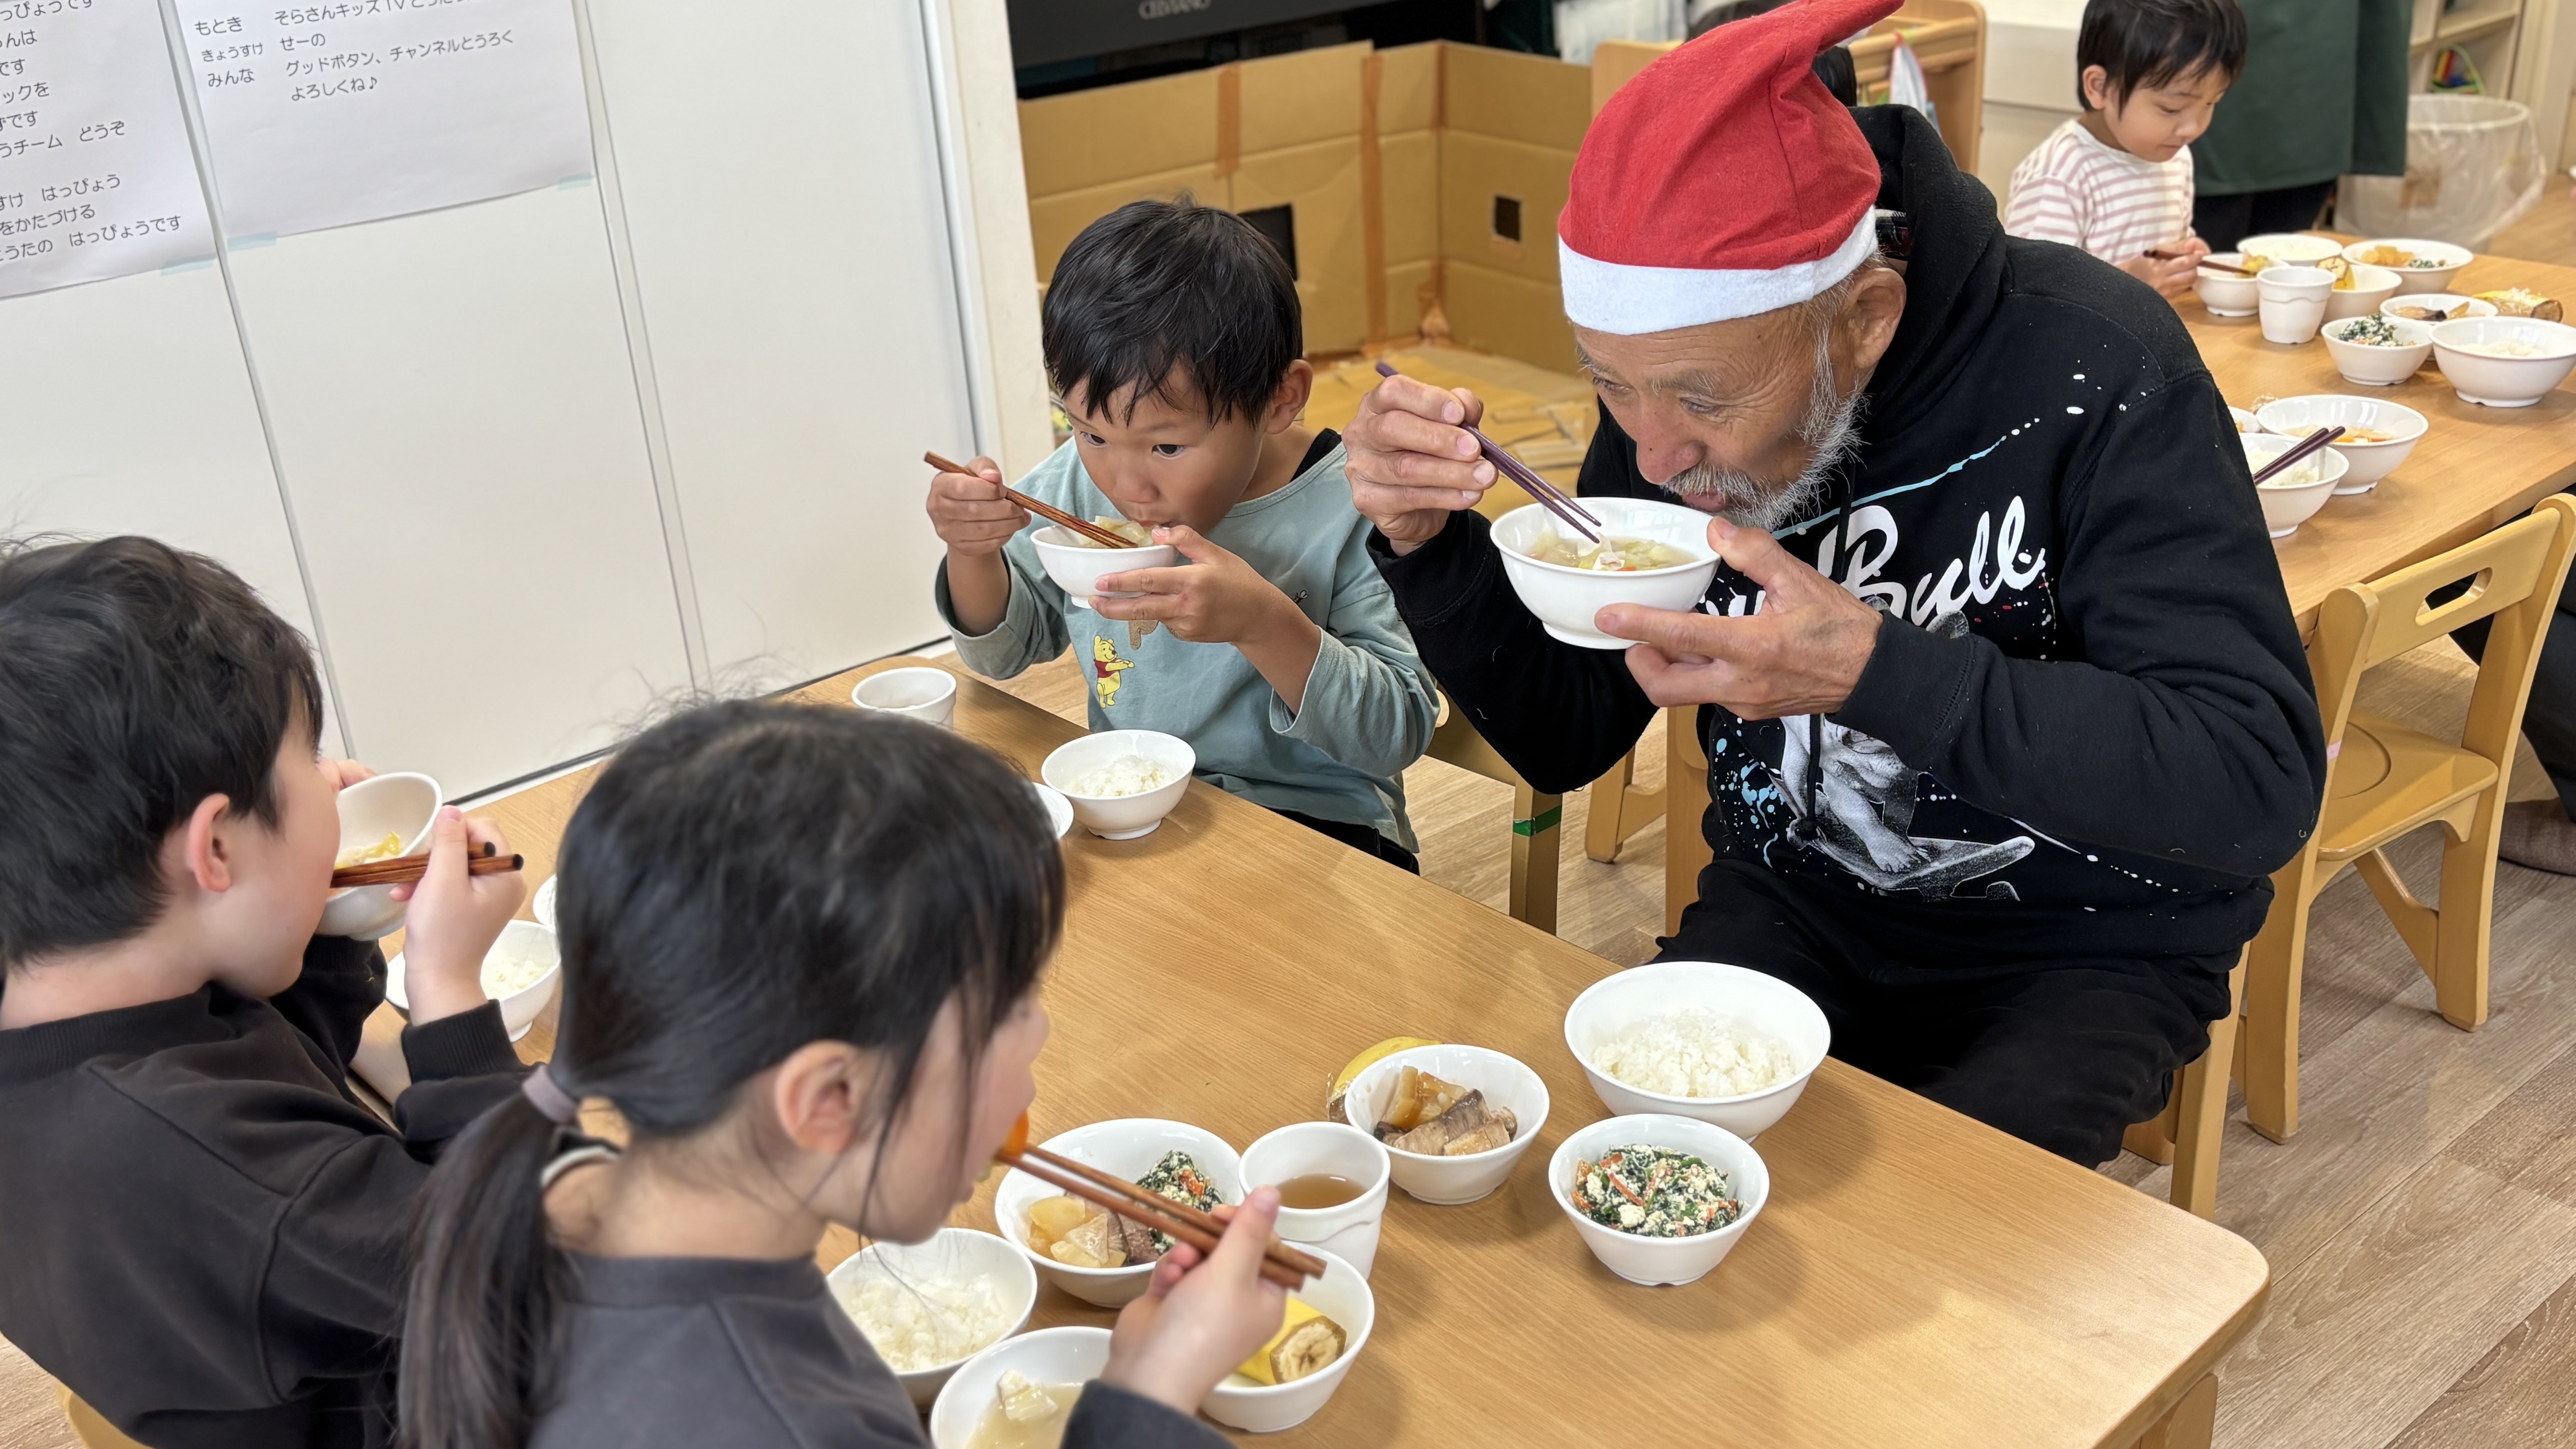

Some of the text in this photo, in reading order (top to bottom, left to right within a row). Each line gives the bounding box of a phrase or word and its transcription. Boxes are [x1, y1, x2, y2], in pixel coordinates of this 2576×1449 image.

[0, 29, 37, 48] んは
[194, 17, 242, 36] もとき
[201, 33, 326, 62] きょうすけ せーの
[207, 69, 255, 87] みんな
[3, 82, 50, 104] ックを
[0, 121, 124, 158] うチーム どうぞ
[41, 174, 120, 201] はっぴょう
[0, 204, 95, 236] をかたづける
[69, 215, 181, 247] はっぴょうです
